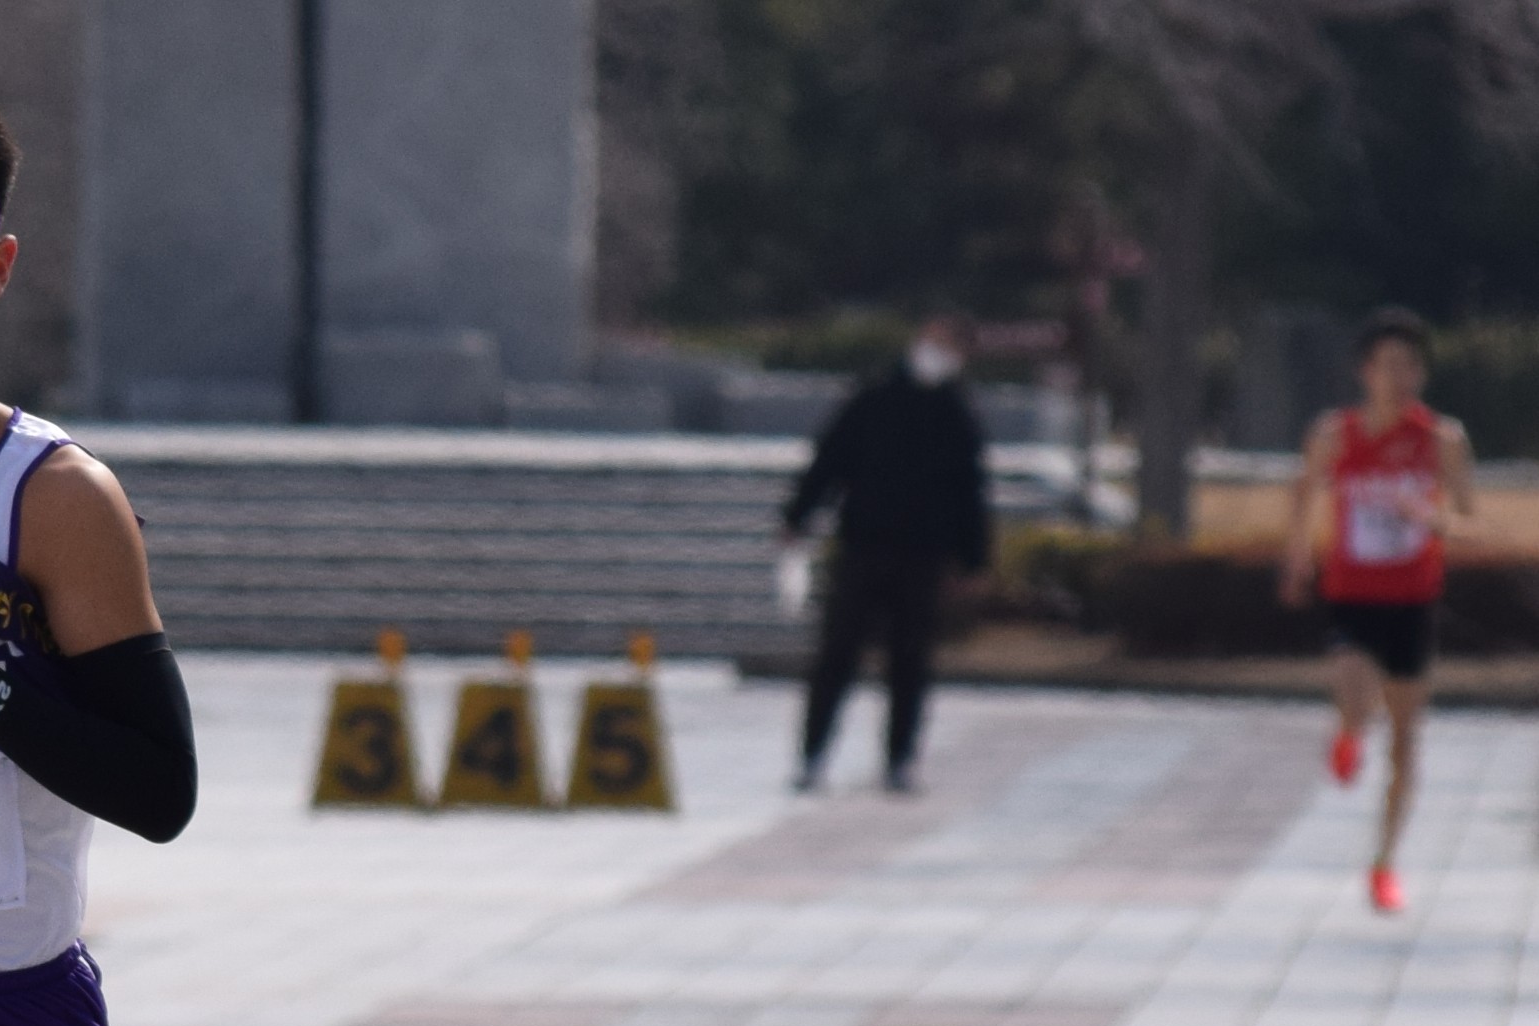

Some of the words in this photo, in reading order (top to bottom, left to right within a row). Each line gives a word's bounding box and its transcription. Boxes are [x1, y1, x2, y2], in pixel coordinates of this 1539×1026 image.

[335, 706, 398, 795] 3
[460, 706, 519, 791] 4
[590, 705, 651, 794] 5
